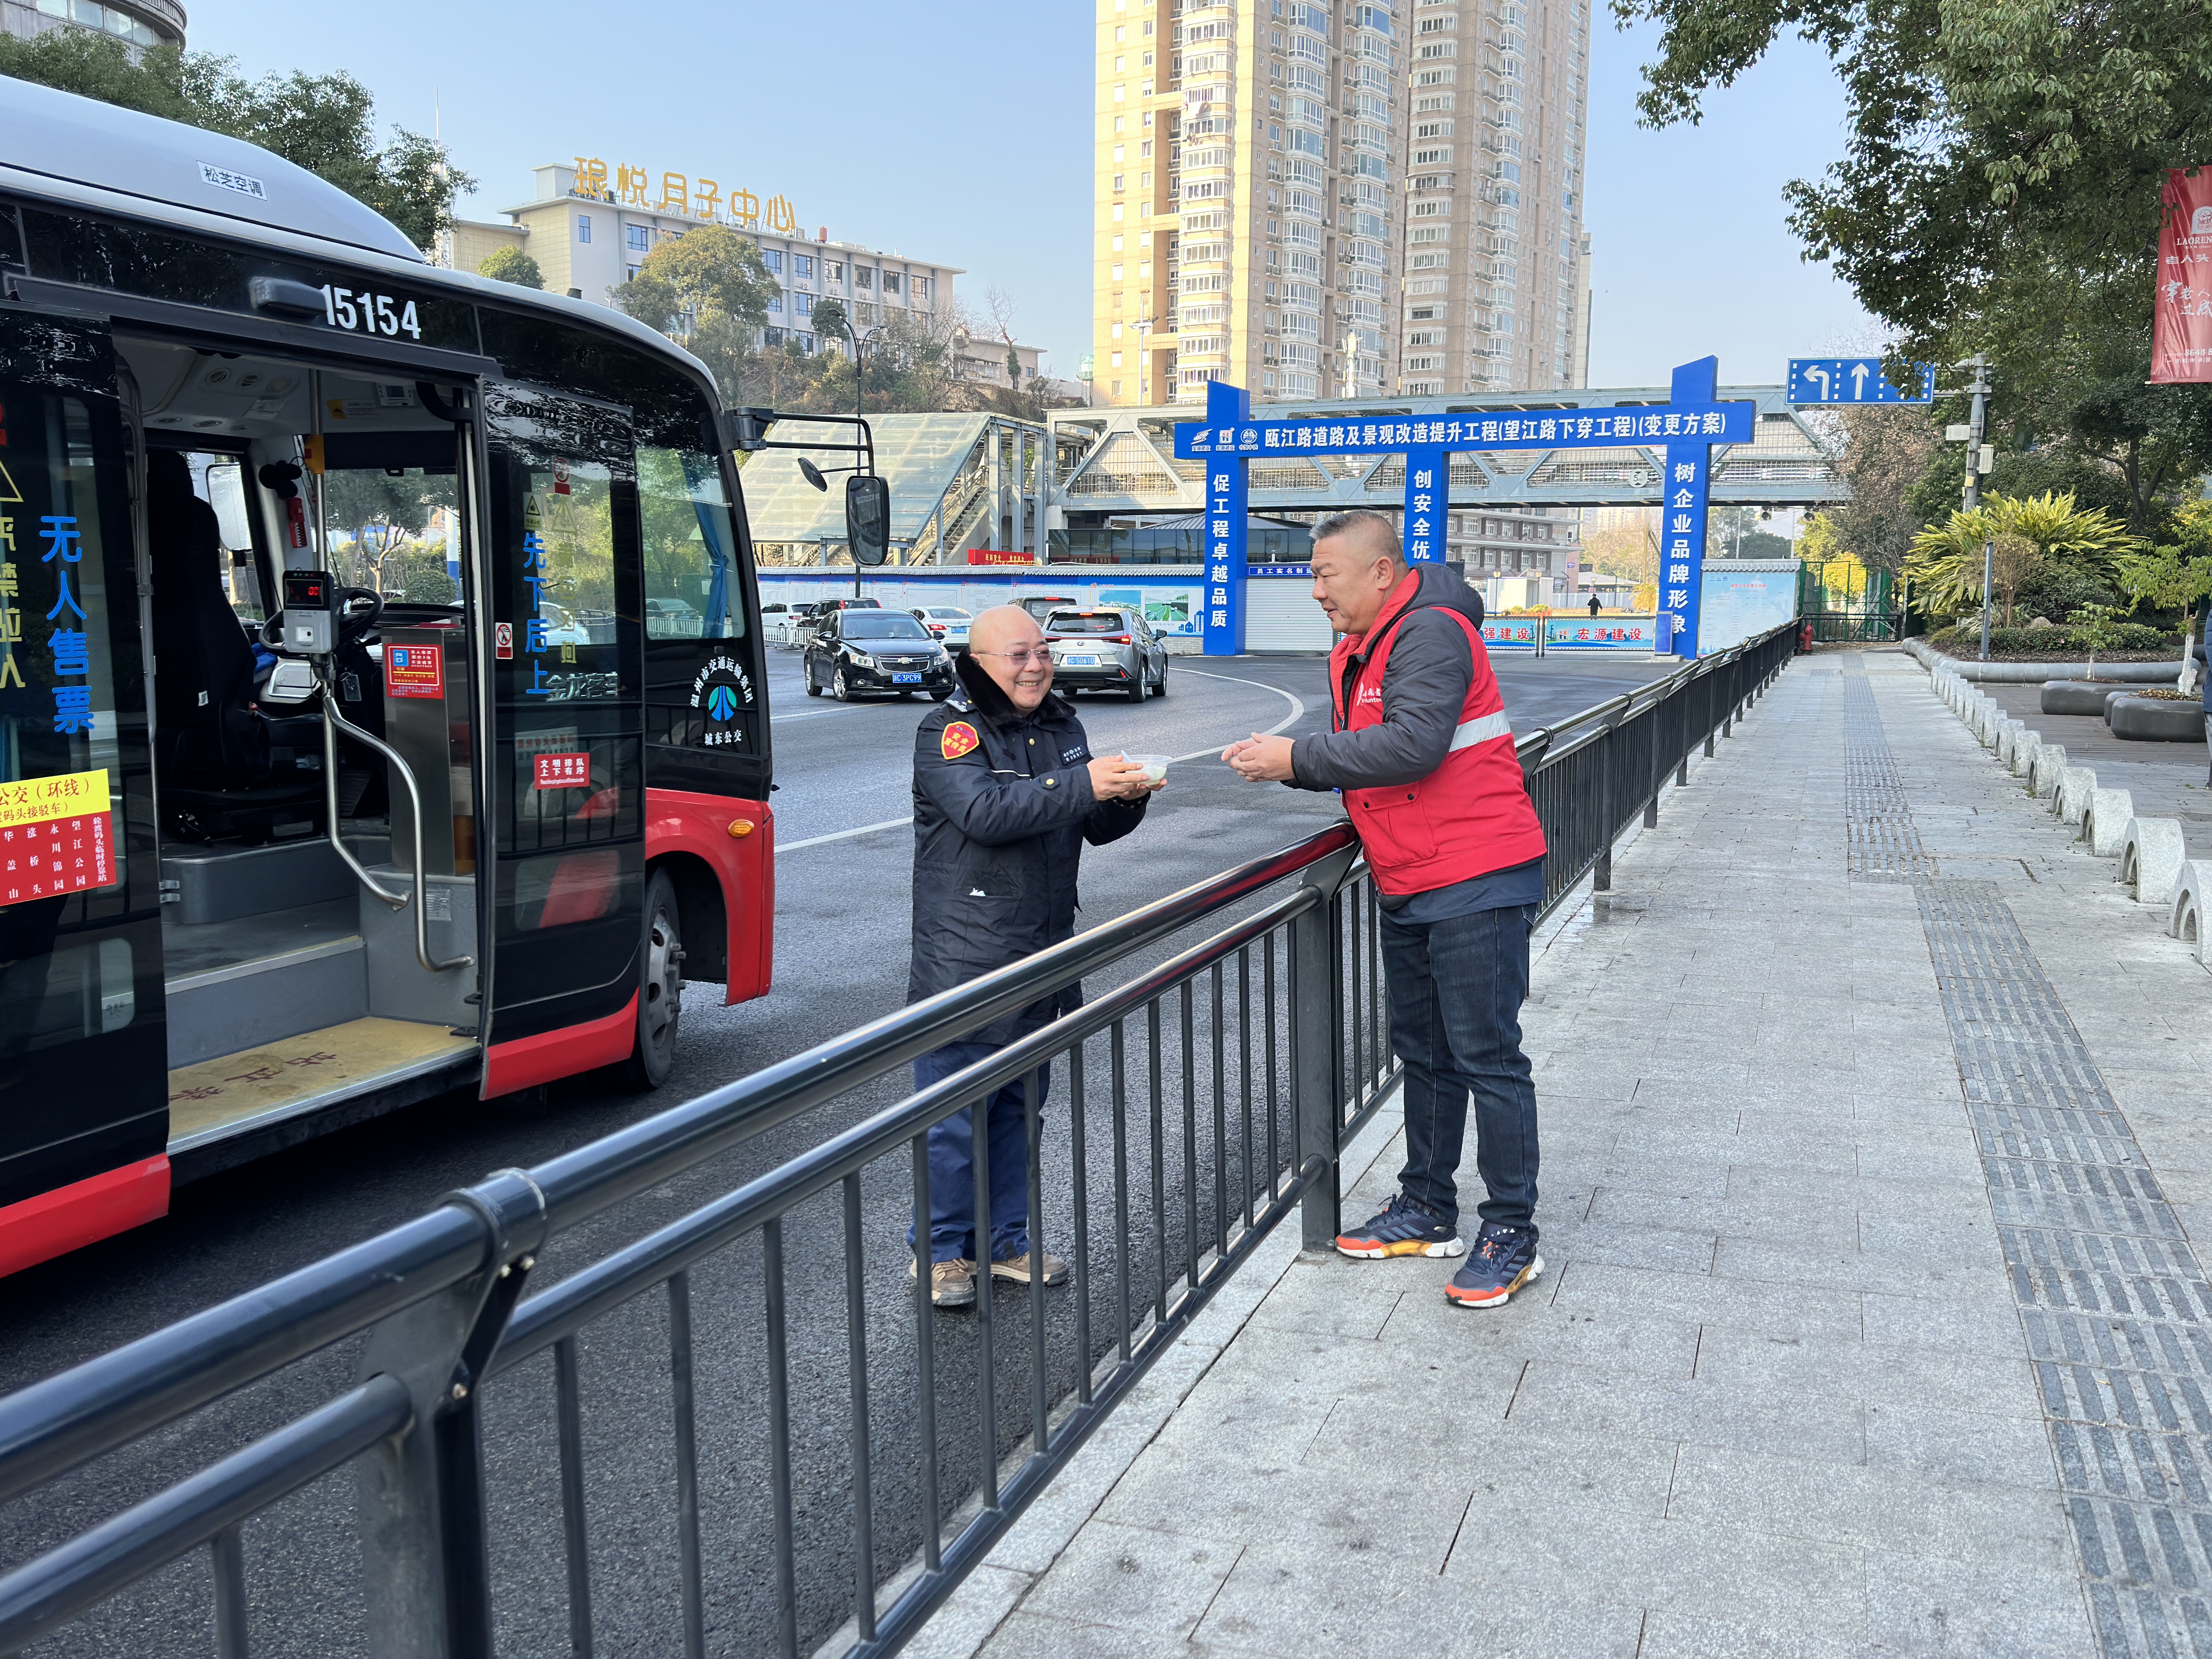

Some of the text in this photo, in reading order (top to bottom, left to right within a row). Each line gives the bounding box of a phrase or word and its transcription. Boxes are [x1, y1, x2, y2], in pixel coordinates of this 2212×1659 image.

[204, 165, 263, 196] 松芝空调
[321, 284, 421, 339] 15154
[2185, 348, 2206, 357] 8648
[1411, 470, 1432, 560] 创安全优
[1211, 474, 1230, 627] 促工程卓越品质
[1667, 462, 1696, 634] 树企业品牌形象
[39, 516, 95, 734] 无人售票
[523, 532, 549, 695] 先下后上
[1484, 627, 1529, 640] 强建设
[1578, 628, 1642, 641] 宏源建设
[690, 656, 753, 707] 温州市交通运输集团
[705, 729, 742, 745] 城东公交
[952, 732, 969, 745] 安全
[540, 758, 584, 768] 文明排队
[540, 766, 584, 776] 上下有序
[0, 802, 68, 822] 码头接驳车）
[72, 820, 86, 887] 望江公园
